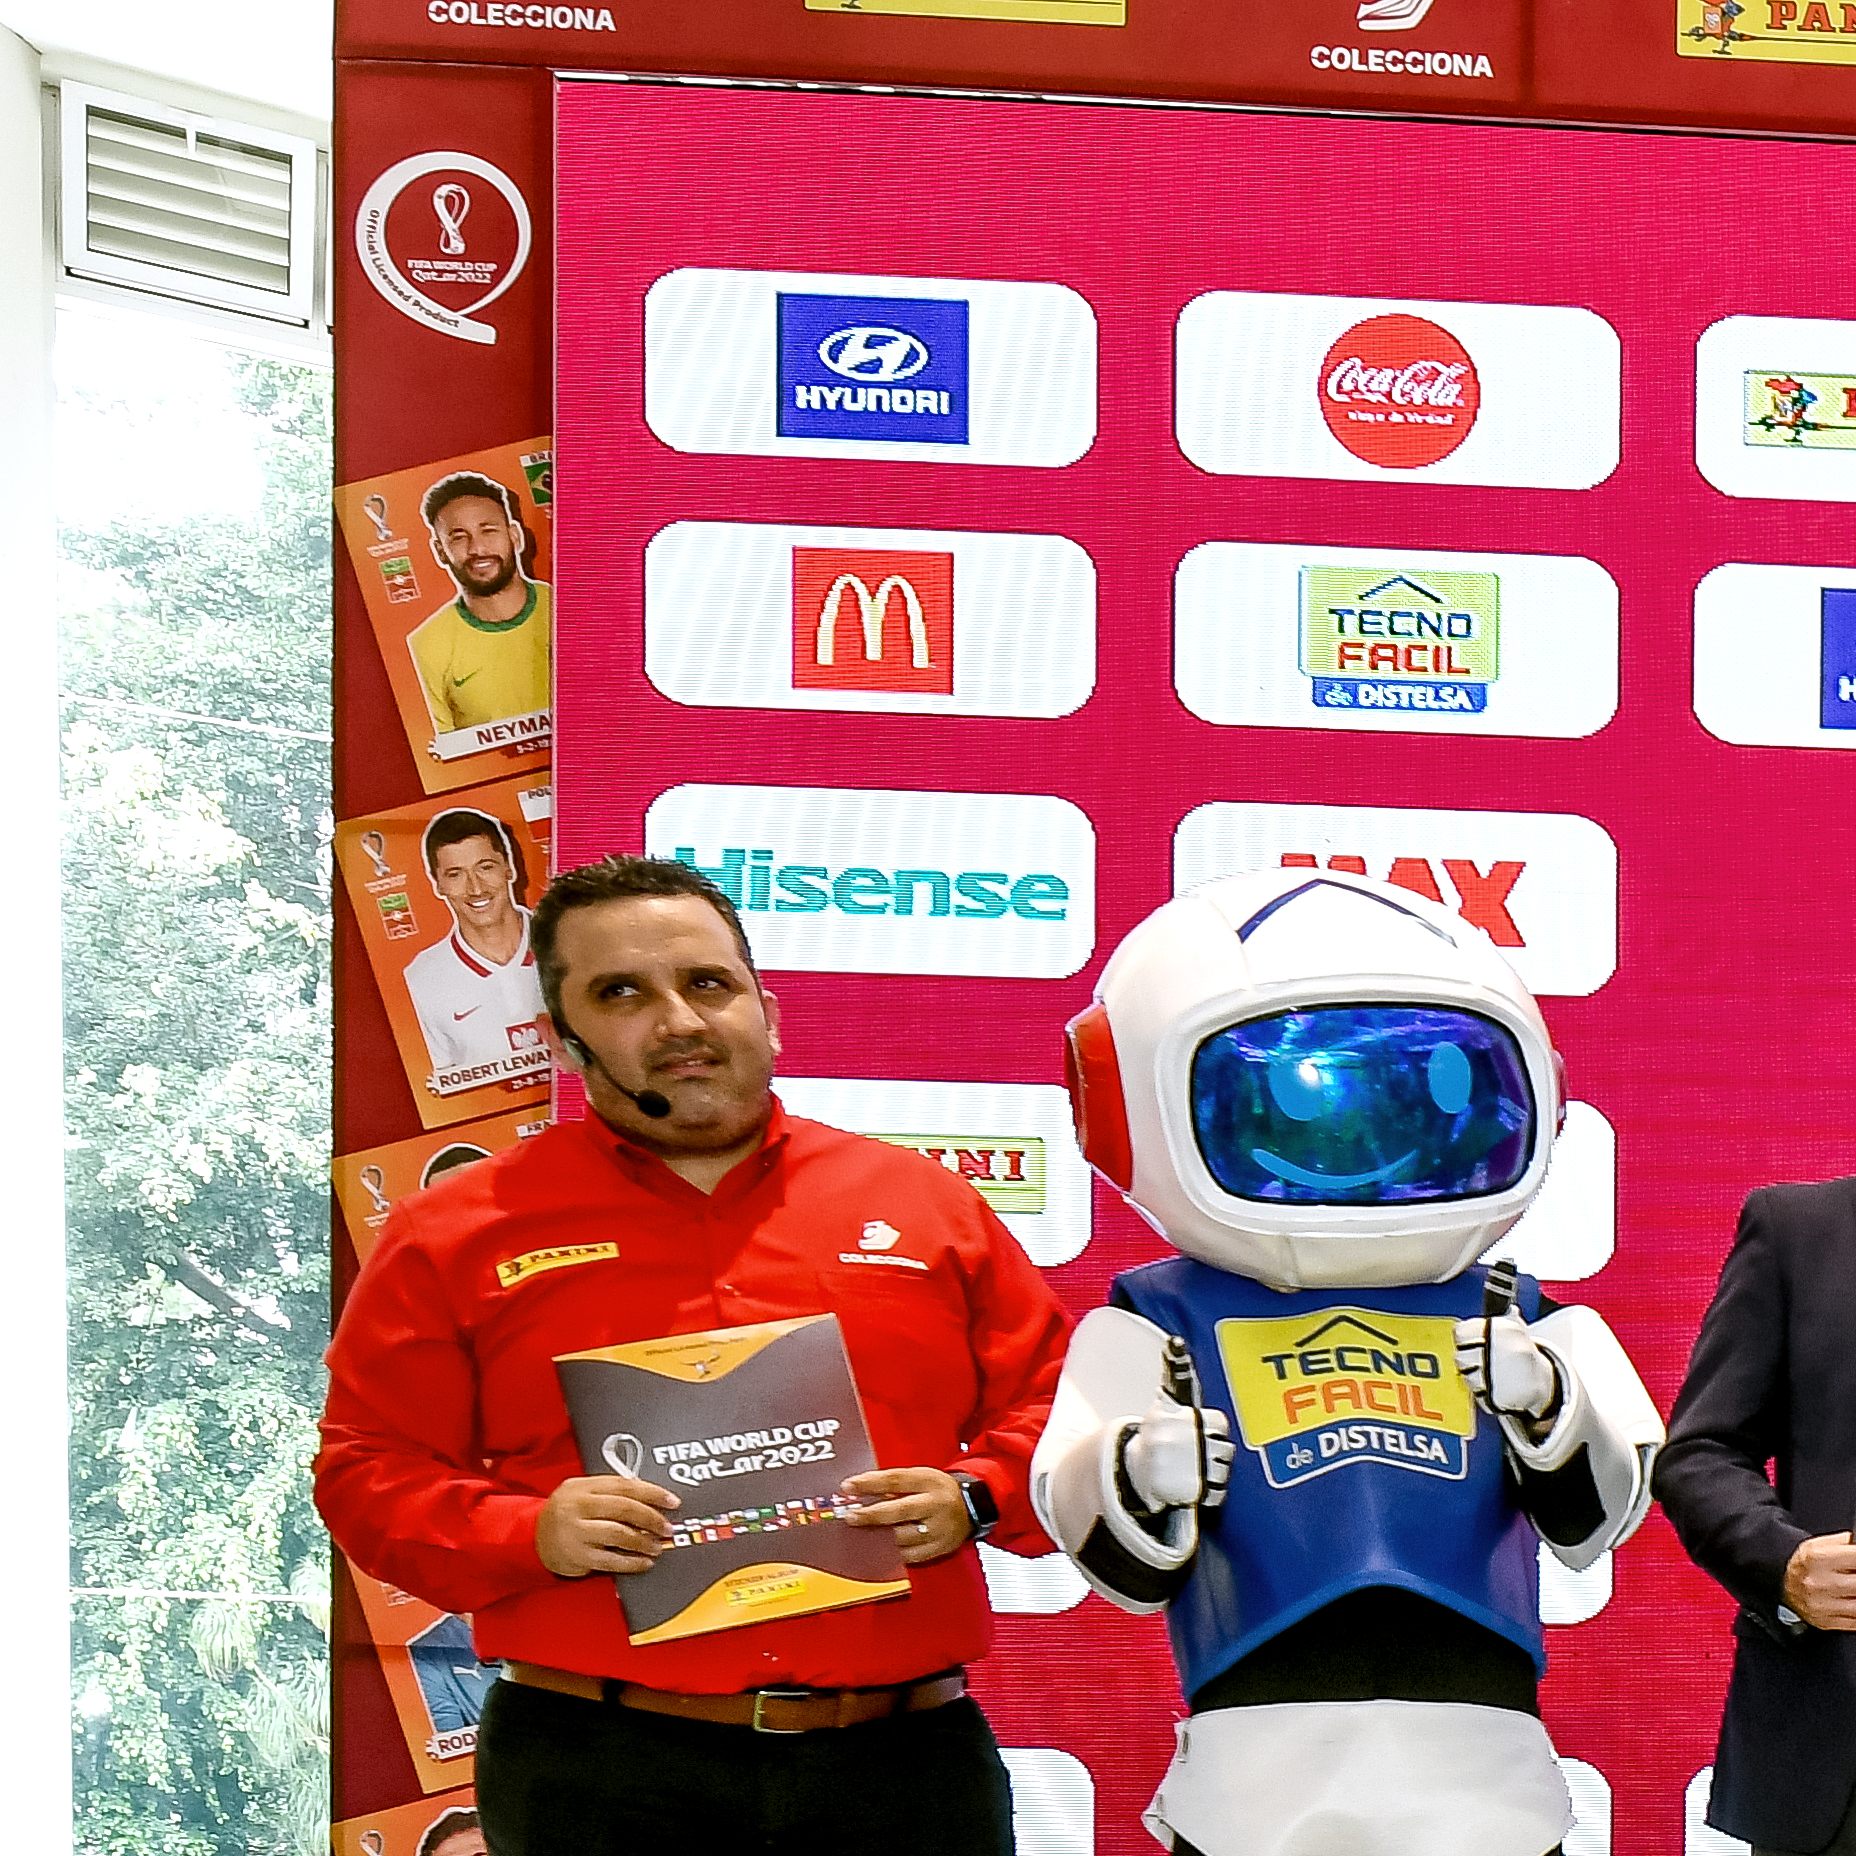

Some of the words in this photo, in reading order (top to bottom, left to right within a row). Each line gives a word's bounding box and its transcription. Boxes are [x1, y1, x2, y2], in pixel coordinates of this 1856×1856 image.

[427, 0, 616, 32] COLECCIONA
[1310, 45, 1494, 78] COLECCIONA
[366, 209, 380, 256] Official
[371, 257, 412, 302] Licensed
[412, 299, 460, 328] Product
[795, 385, 951, 415] HYUNDAI
[1329, 608, 1472, 638] TECNO
[1338, 642, 1471, 674] FACIL
[1357, 683, 1474, 710] DISTELSA
[476, 715, 551, 746] NEYMA
[673, 848, 1068, 922] Hisense
[439, 1061, 499, 1089] ROBERT
[528, 1243, 613, 1264] PANINI
[1262, 1346, 1440, 1383] TECNO
[1284, 1380, 1444, 1425] FACIL
[653, 1441, 701, 1465] FIFA
[703, 1427, 793, 1455] WORLD
[794, 1419, 841, 1440] CUP
[1286, 1444, 1314, 1468] de
[1317, 1427, 1450, 1465] DISTELSA
[438, 1731, 477, 1753] ROD
